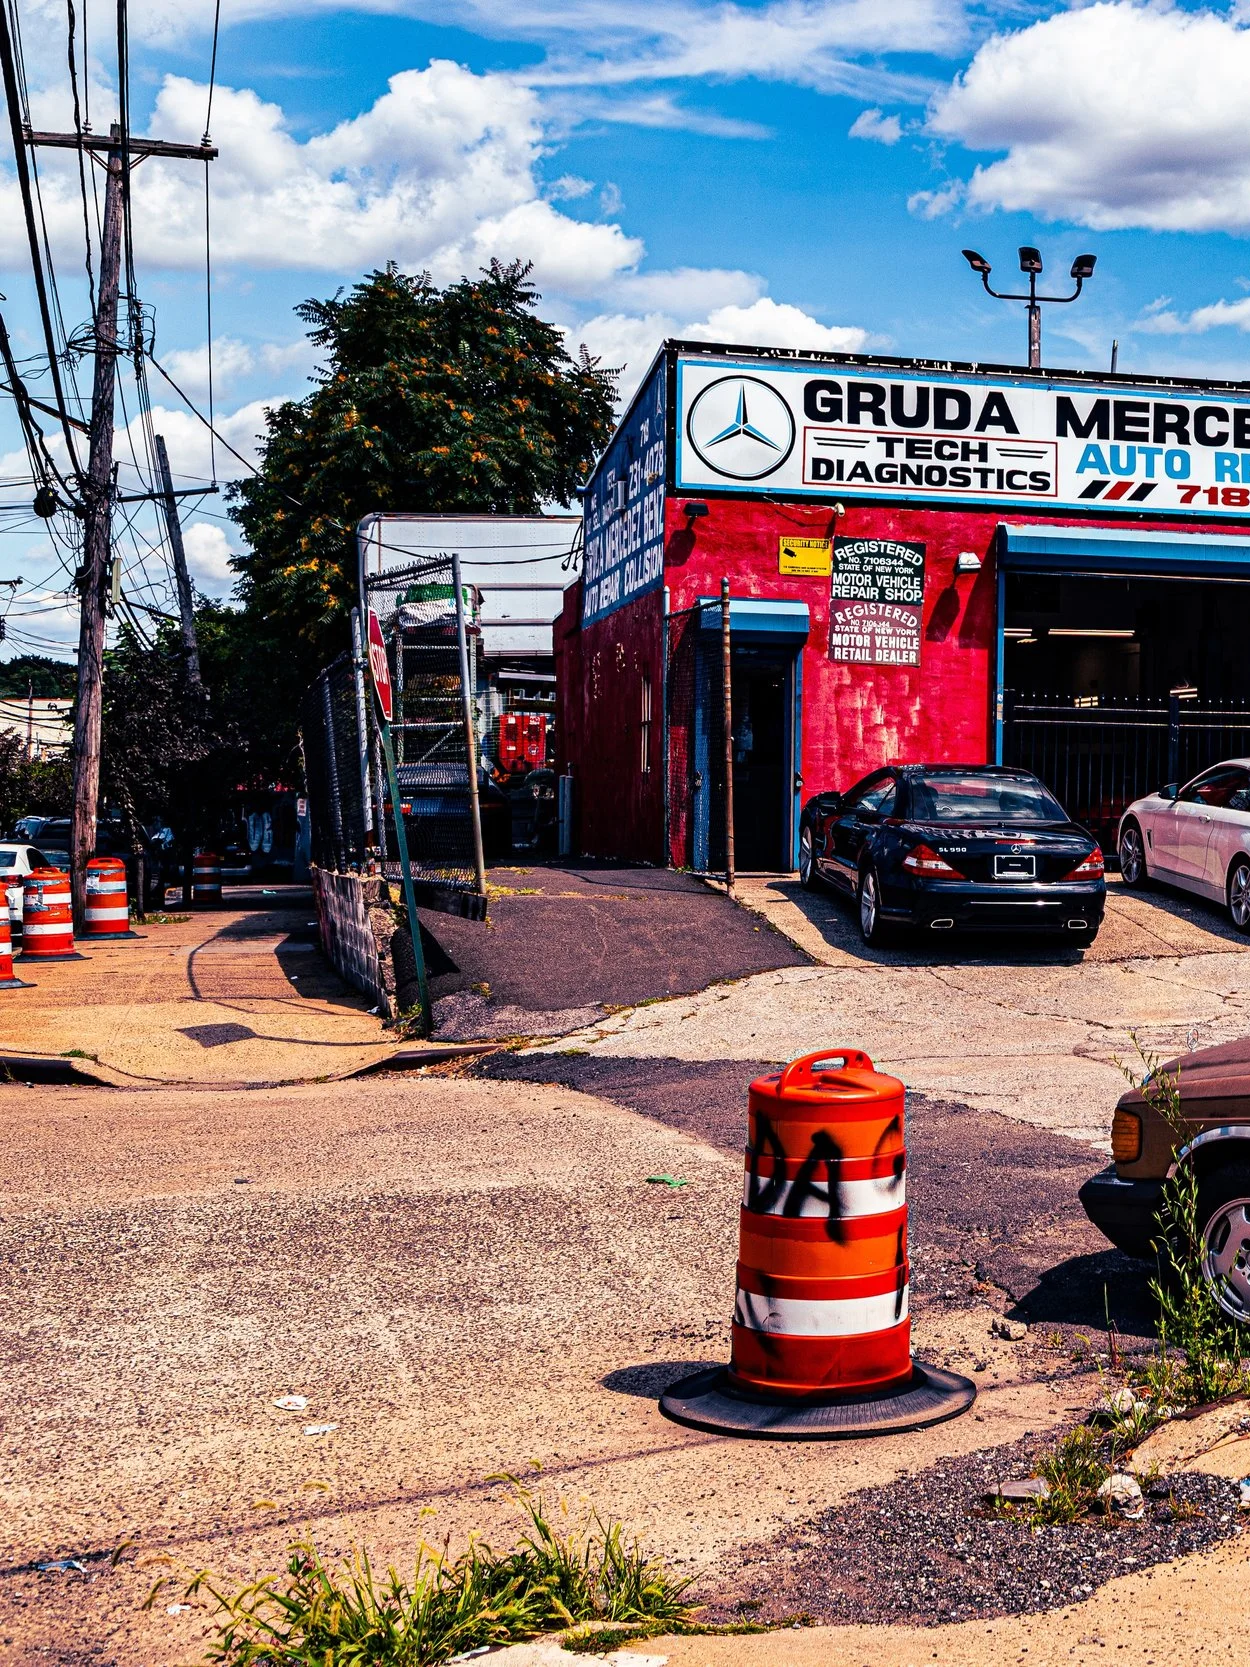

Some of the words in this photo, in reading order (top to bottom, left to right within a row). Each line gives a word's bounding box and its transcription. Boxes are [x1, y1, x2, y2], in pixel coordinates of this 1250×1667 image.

[803, 380, 1021, 435] GRUDA
[640, 418, 649, 447] 718
[876, 436, 988, 463] TECH
[1076, 443, 1191, 480] AUTO
[628, 440, 664, 500] 231-4078
[811, 457, 1051, 492] DIAGNOSTICS
[605, 501, 641, 571] MERCEDEZ
[643, 484, 665, 545] BENZ
[783, 539, 809, 548] SECURITY
[810, 540, 828, 549] NOTICE
[834, 541, 923, 566] REGISTERED
[838, 563, 860, 571] STATE
[894, 567, 914, 575] YORK
[863, 557, 904, 566] 7106344
[584, 585, 599, 620] AUTO
[624, 542, 664, 596] COLLISION
[832, 572, 872, 587] MOTOR
[876, 575, 921, 590] VEHICLE
[832, 585, 879, 600] REPAIR
[885, 588, 923, 602] SHOP
[834, 603, 918, 628] REGISTERED
[832, 633, 871, 647] MOTOR
[875, 636, 919, 650] VEHICLE
[834, 625, 859, 633] STATE
[896, 628, 917, 636] YORK
[370, 642, 388, 685] STOP
[834, 647, 872, 661] RETAIL
[876, 649, 917, 663] DEALER
